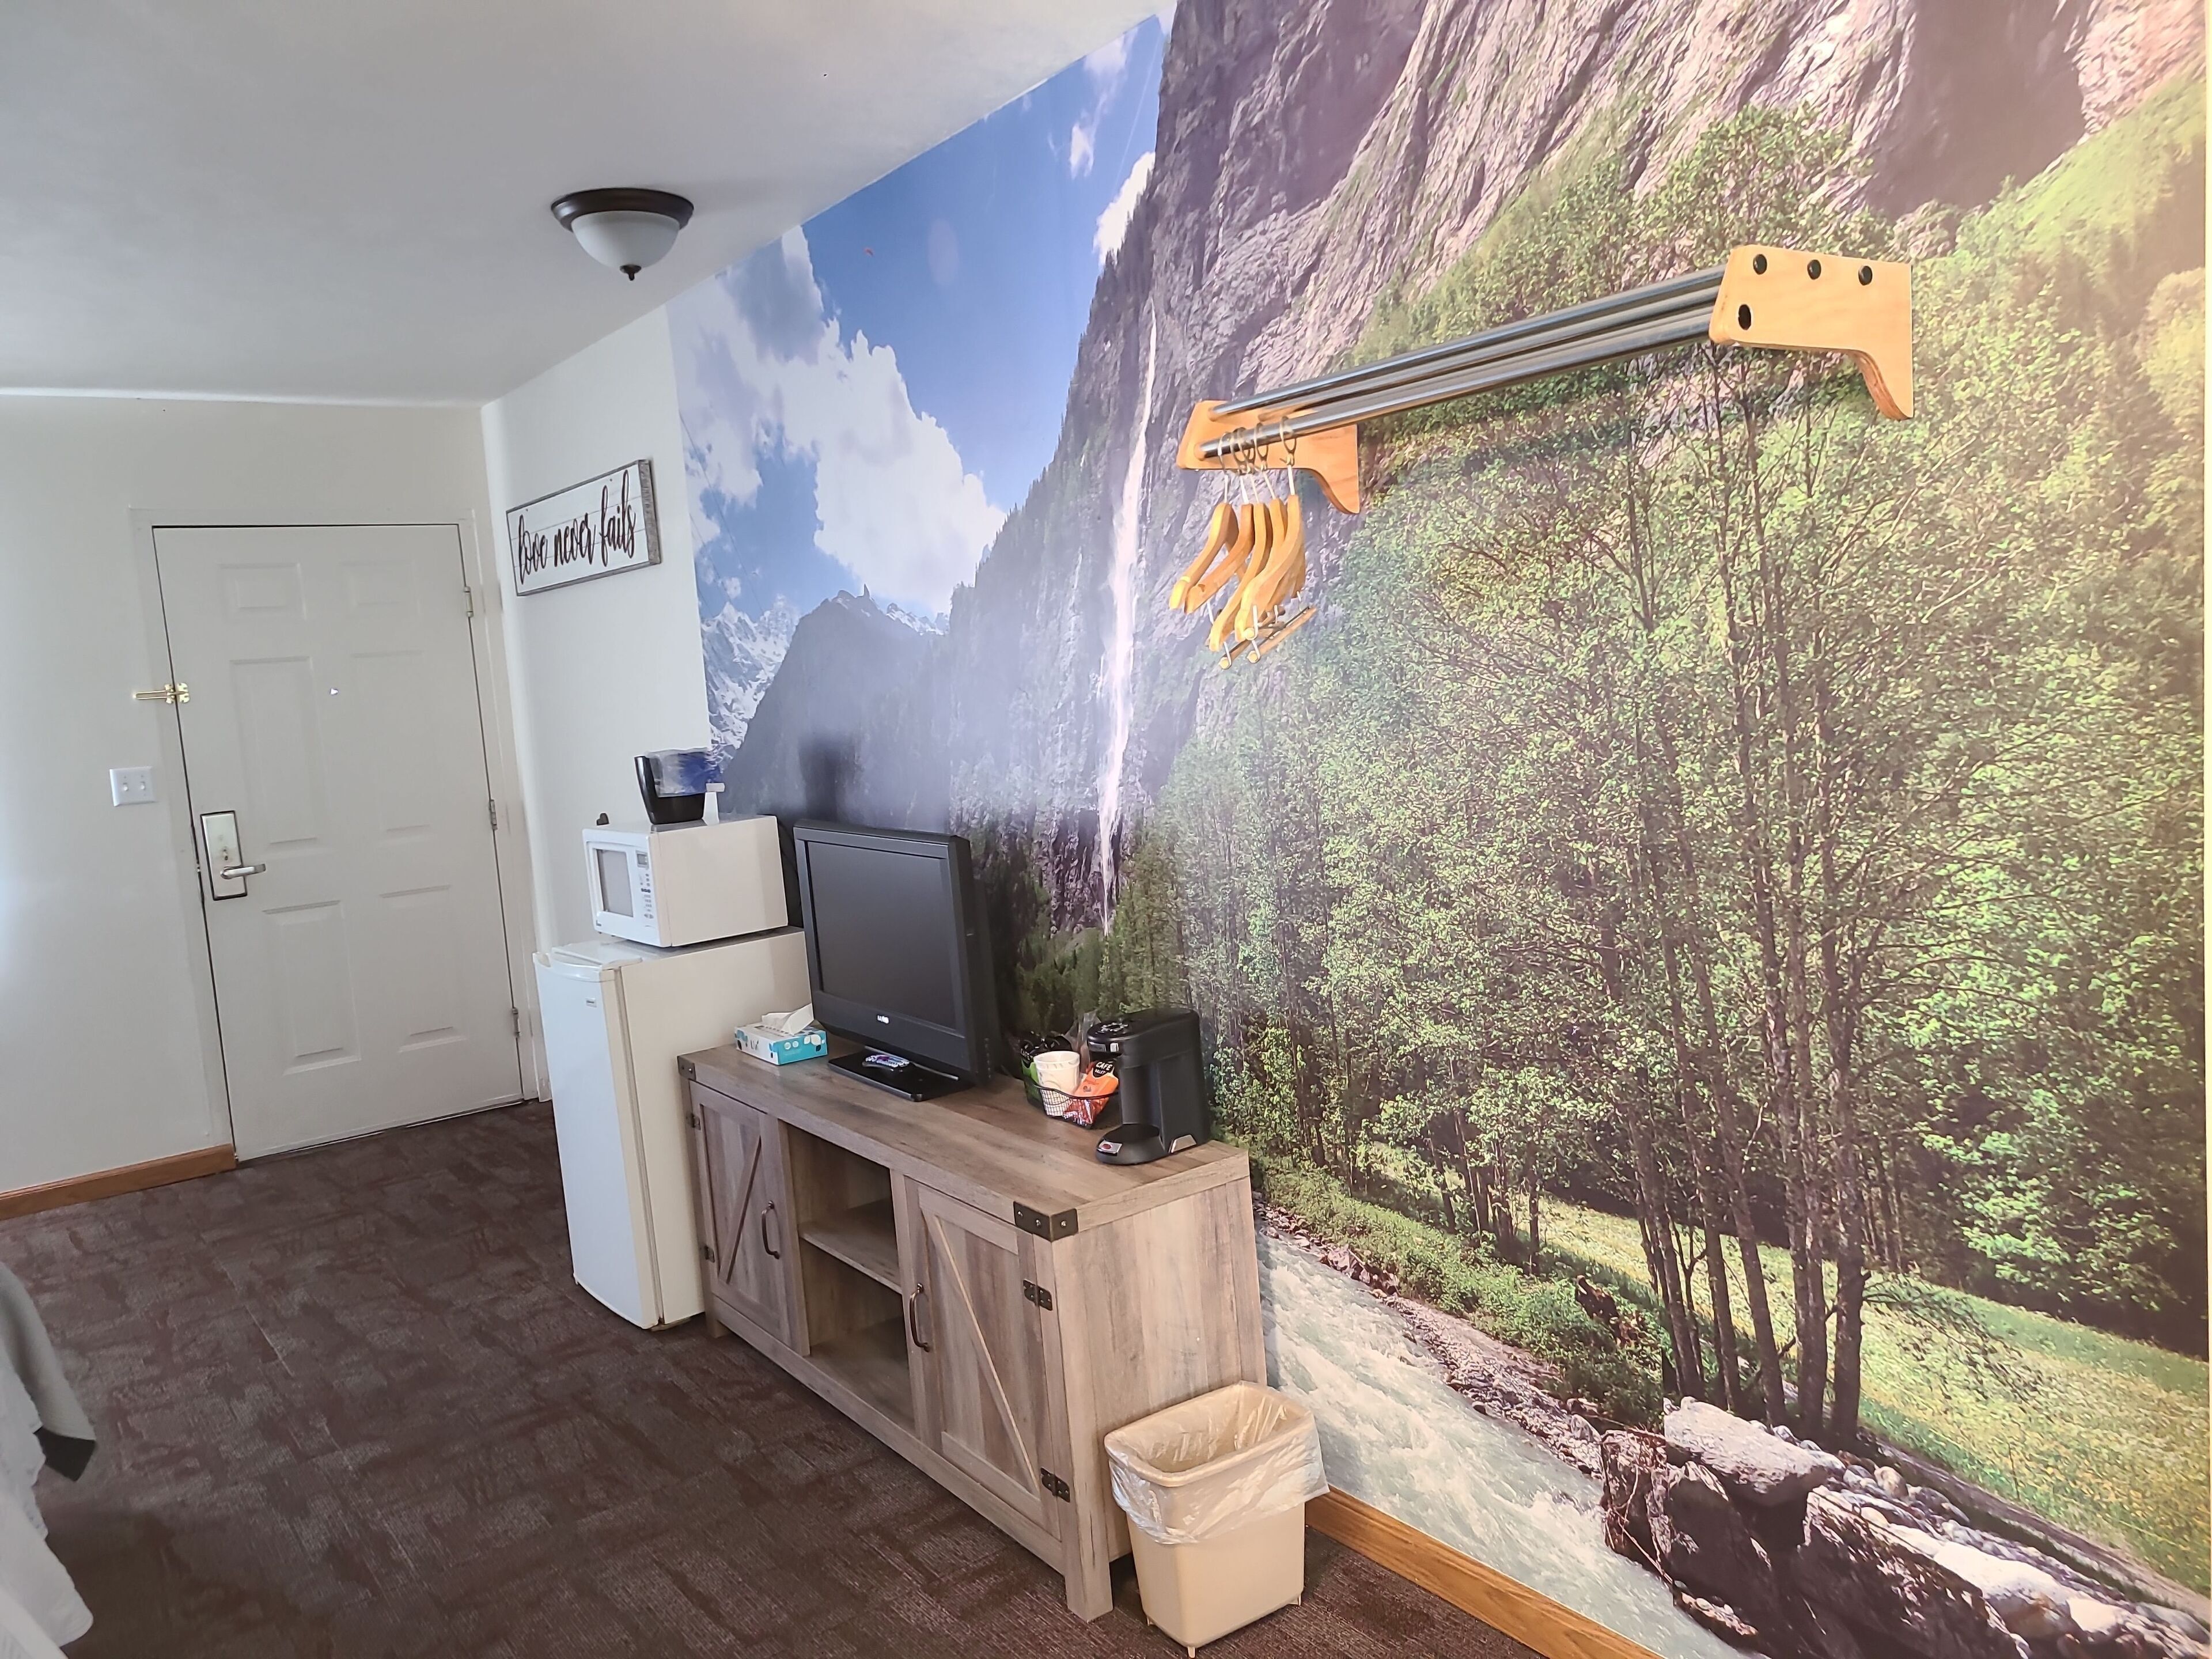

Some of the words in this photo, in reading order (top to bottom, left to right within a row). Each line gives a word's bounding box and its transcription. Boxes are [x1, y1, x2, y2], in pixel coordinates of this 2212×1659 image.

[518, 514, 548, 585] love
[554, 512, 596, 567] never
[599, 469, 636, 567] fails
[1096, 1062, 1113, 1070] CAFE
